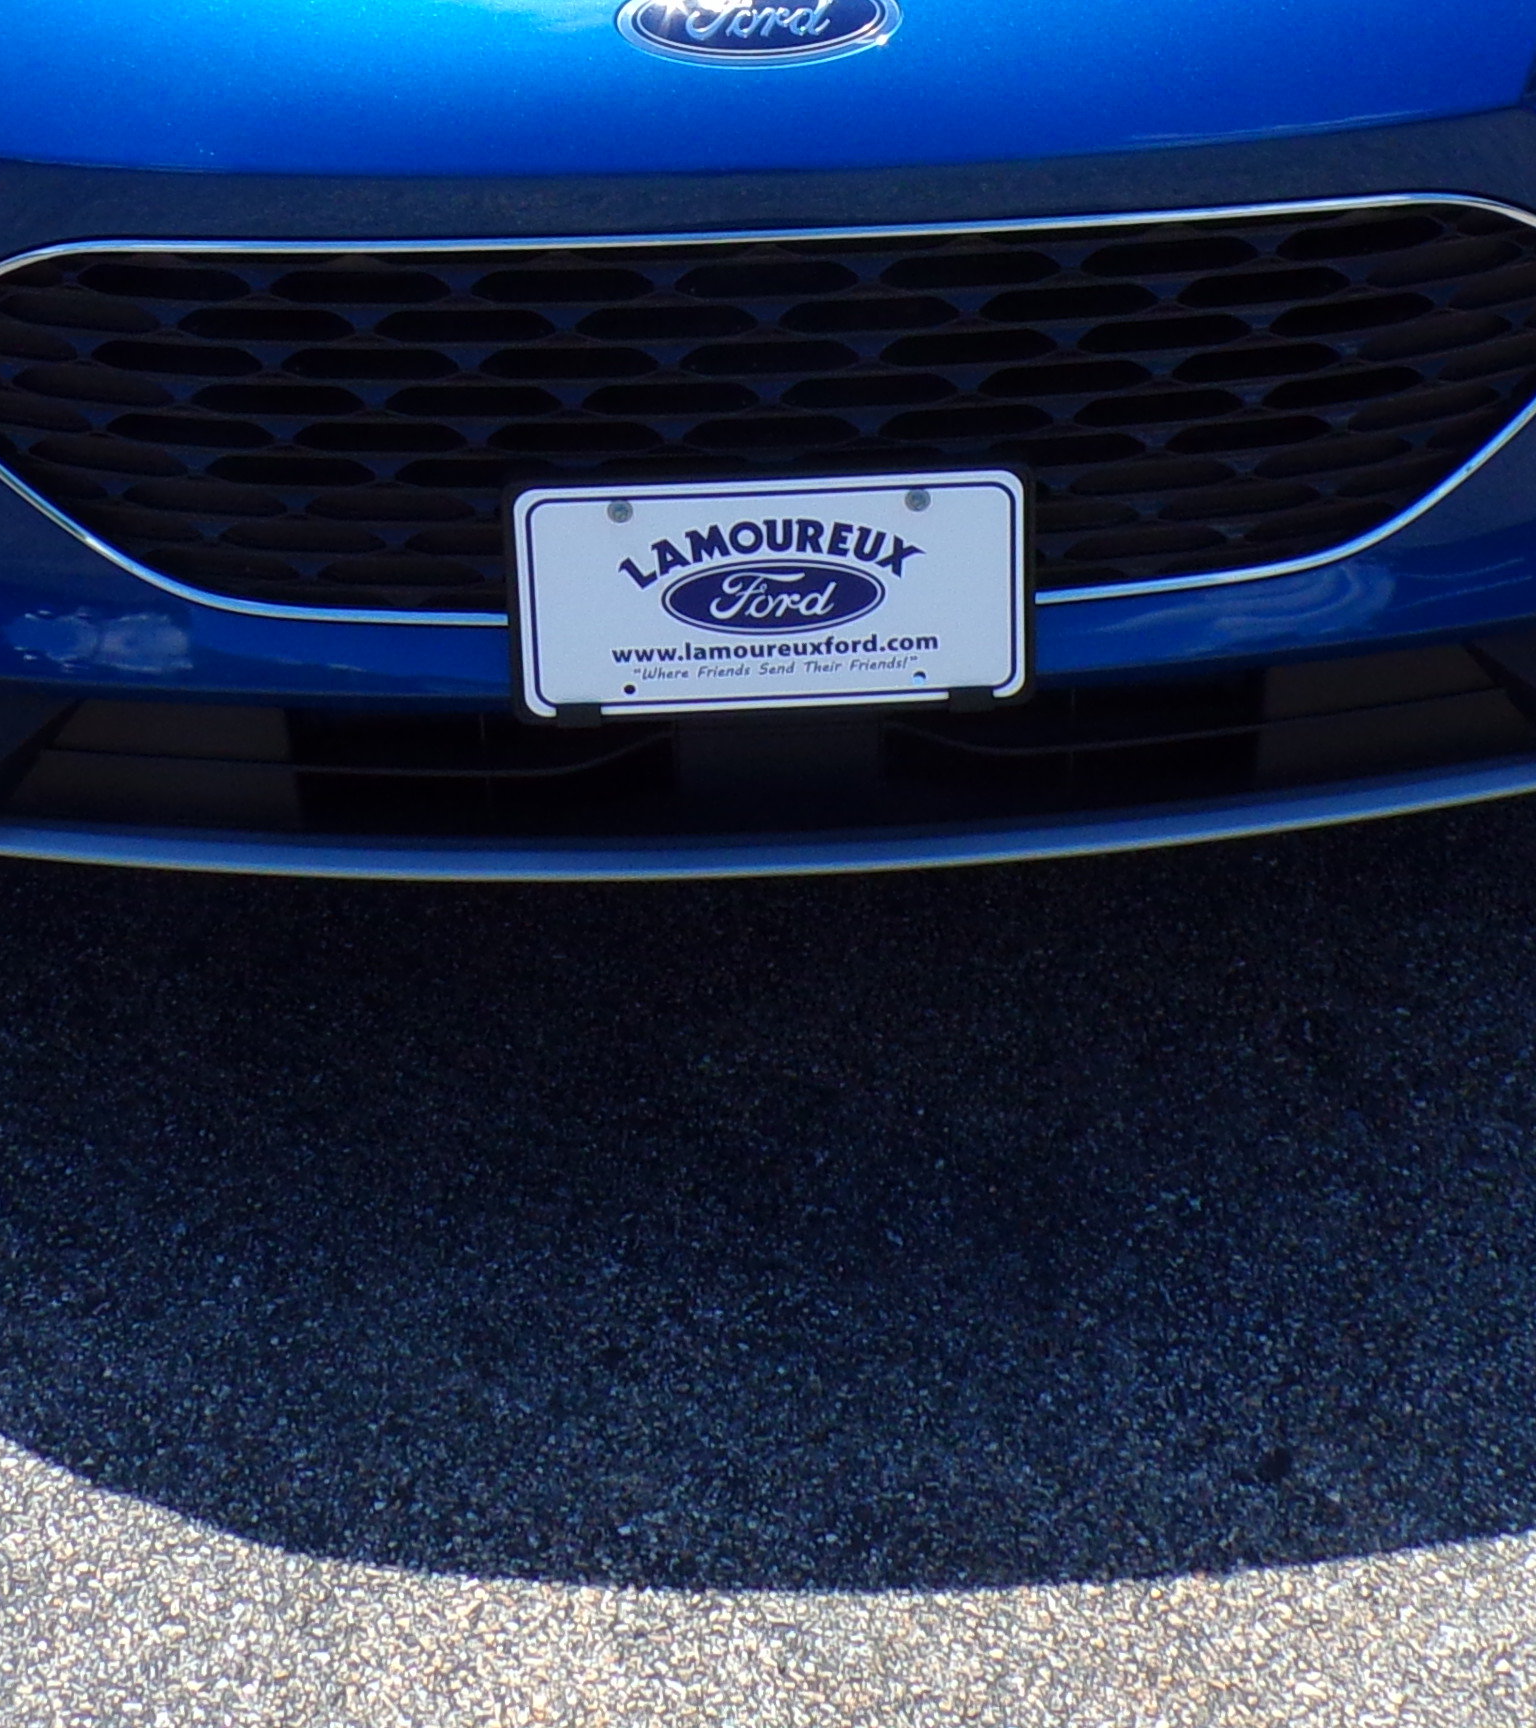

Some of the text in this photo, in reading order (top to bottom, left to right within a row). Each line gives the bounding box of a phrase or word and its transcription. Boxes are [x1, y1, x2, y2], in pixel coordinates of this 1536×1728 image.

[618, 518, 926, 591] LAMOUREUX
[709, 572, 837, 620] Ford
[612, 633, 939, 664] www.lamoureuxford.com
[697, 663, 751, 679] Friends
[759, 661, 795, 676] Send
[803, 659, 843, 673] Their
